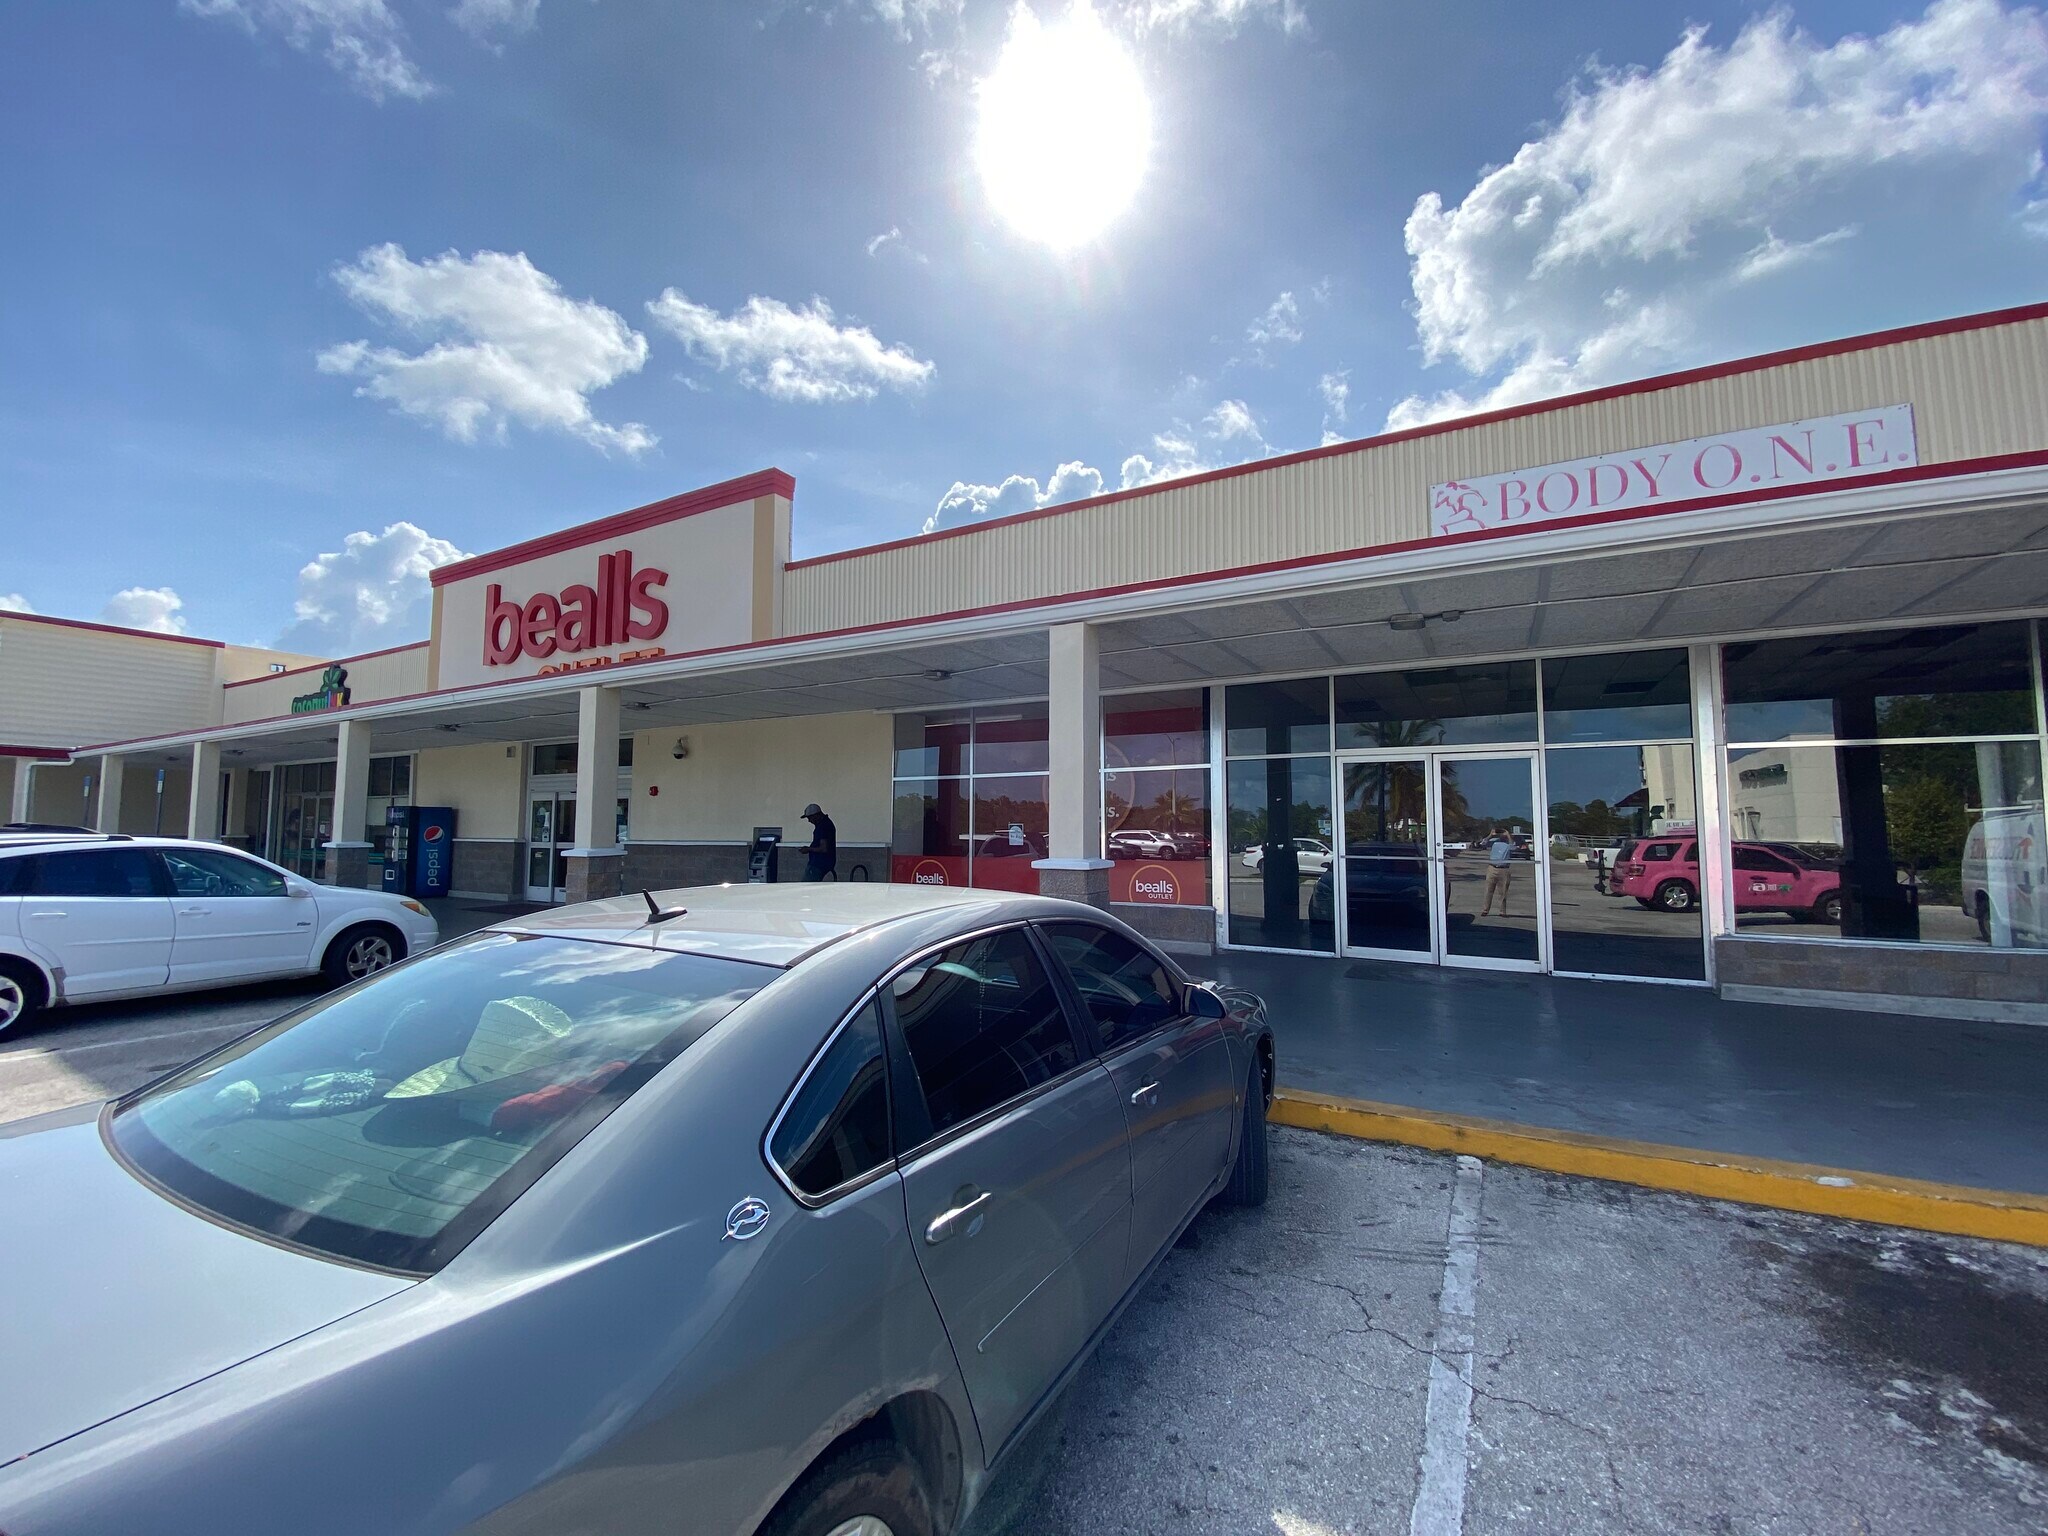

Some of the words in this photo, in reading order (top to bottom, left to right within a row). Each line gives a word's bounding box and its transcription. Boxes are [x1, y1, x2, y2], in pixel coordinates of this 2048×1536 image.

[1496, 453, 1673, 521] BODY
[1693, 418, 1909, 489] O.N.E.
[483, 549, 669, 666] bealls
[426, 849, 441, 886] pepsi
[915, 872, 944, 885] bealls
[1135, 879, 1173, 894] bealls
